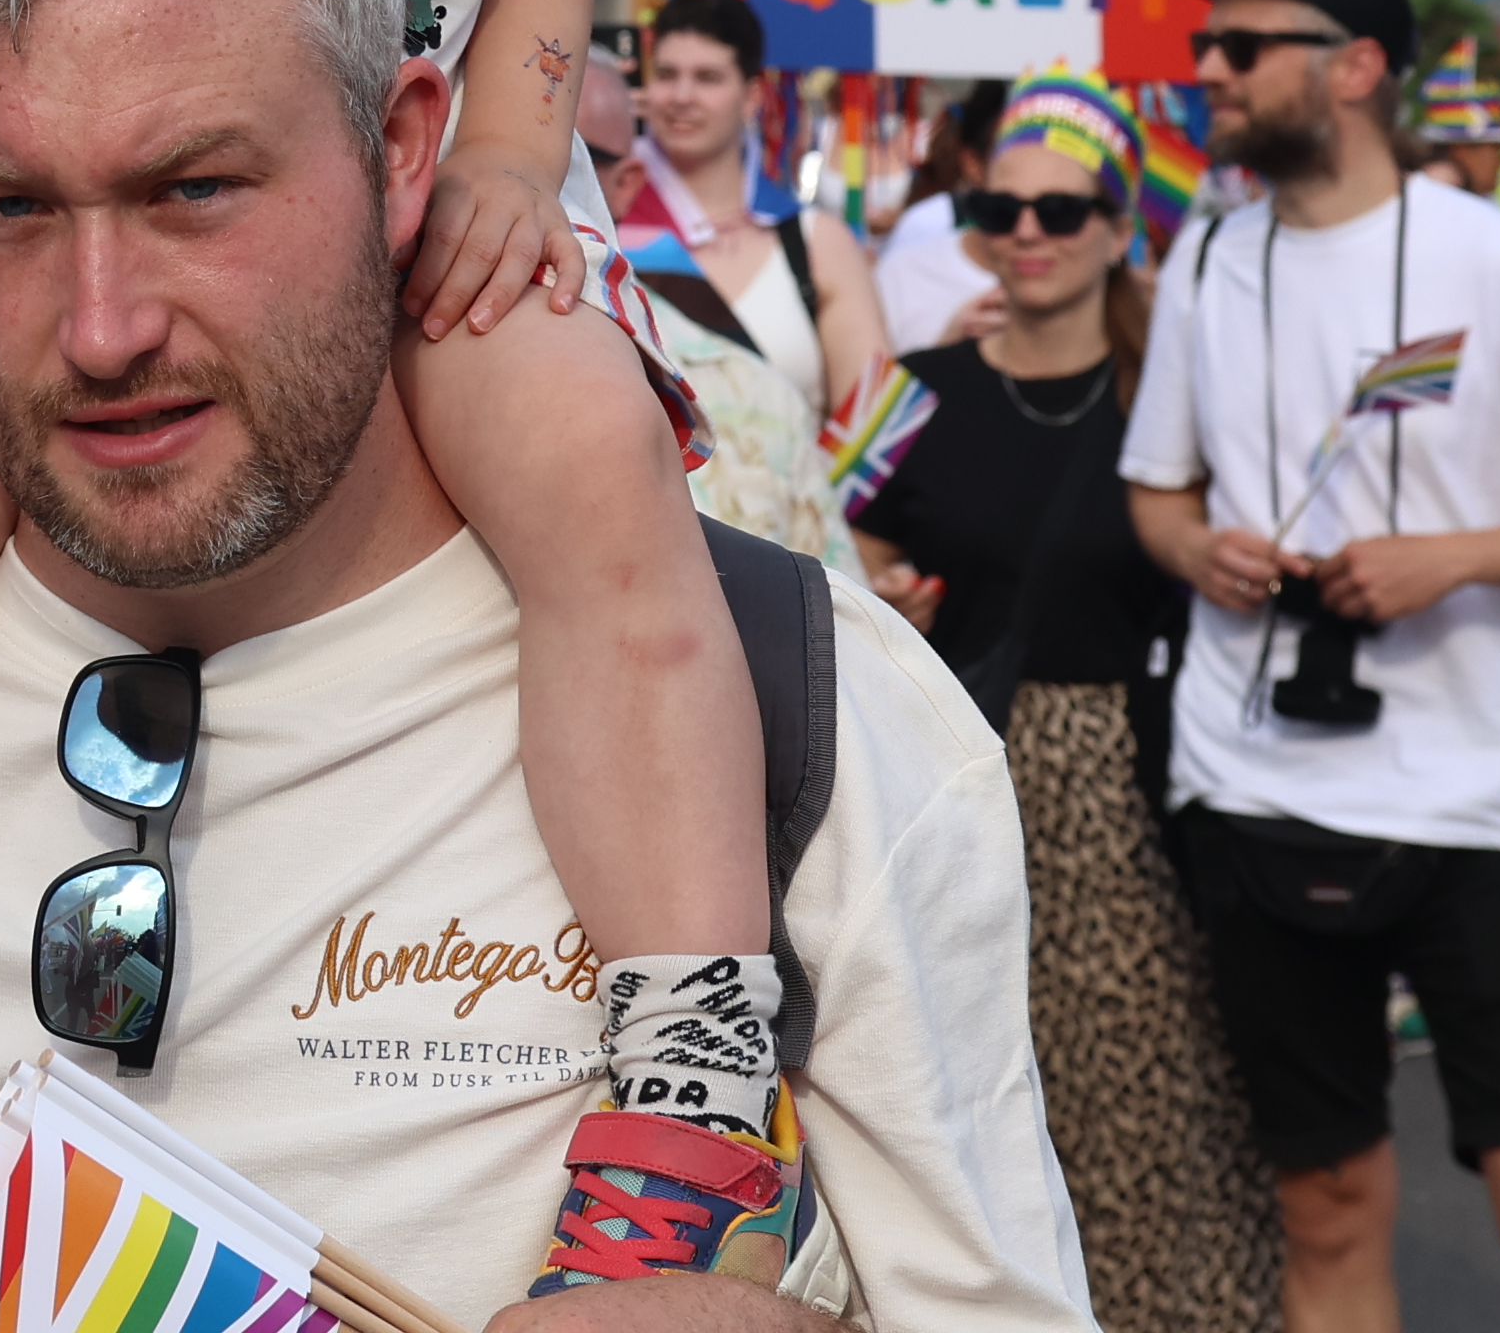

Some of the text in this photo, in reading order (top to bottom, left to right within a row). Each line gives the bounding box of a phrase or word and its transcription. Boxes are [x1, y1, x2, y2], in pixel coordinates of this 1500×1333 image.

[292, 911, 546, 1019] Montego
[297, 1038, 411, 1060] WALTER
[423, 1041, 572, 1065] FLETCHER
[354, 1066, 603, 1088] FROM DUSK TIL DAW
